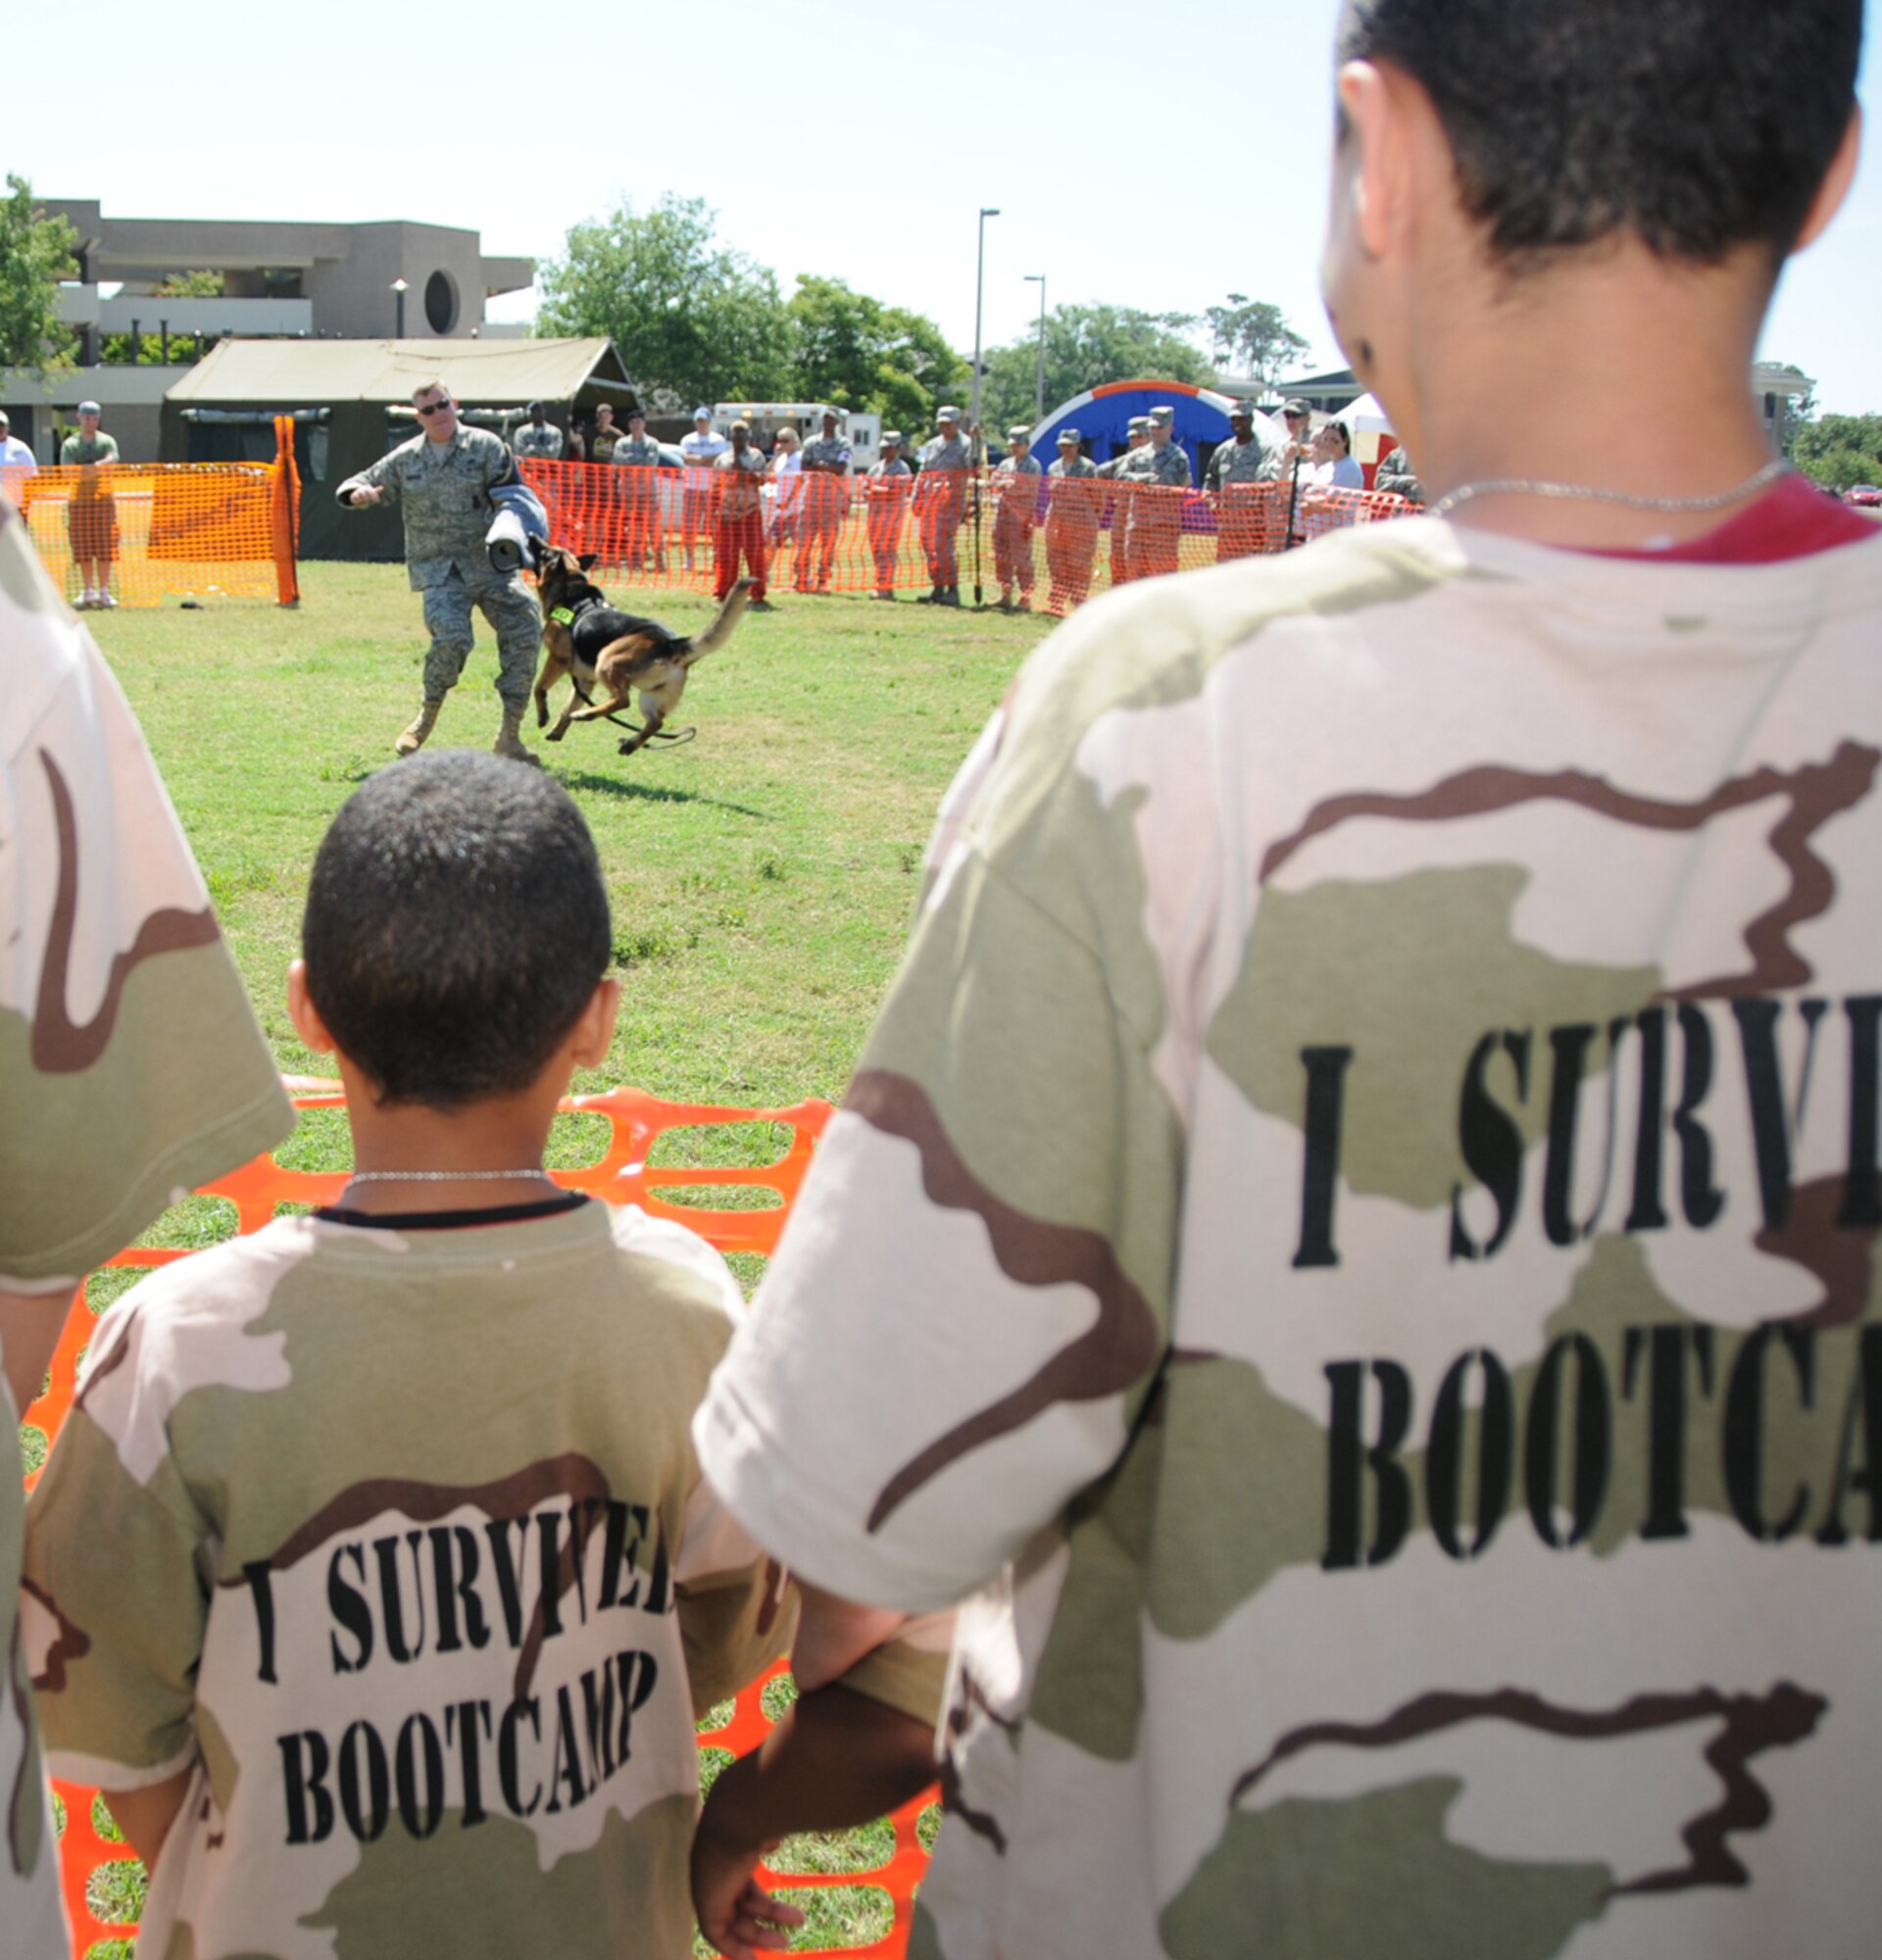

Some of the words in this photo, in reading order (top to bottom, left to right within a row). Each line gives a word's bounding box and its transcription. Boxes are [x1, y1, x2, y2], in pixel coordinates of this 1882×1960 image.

[1291, 1046, 1354, 1268] I
[242, 1560, 278, 1685] I
[276, 1650, 658, 1846] BOOTCAMP
